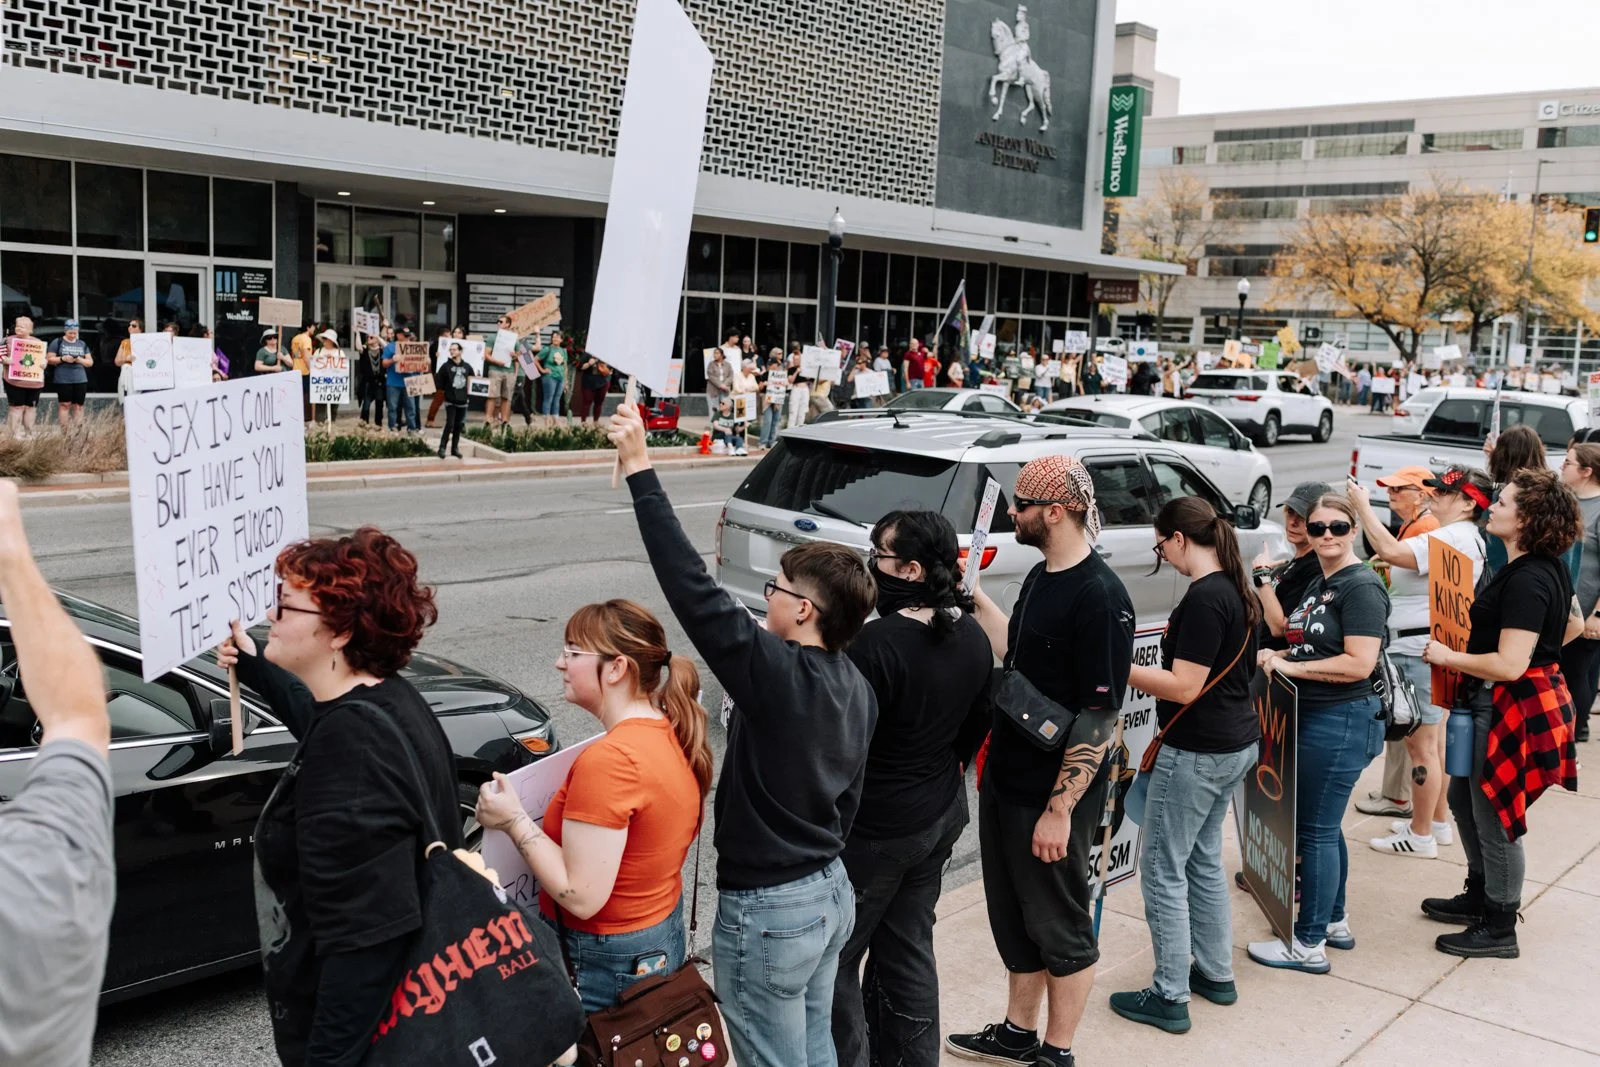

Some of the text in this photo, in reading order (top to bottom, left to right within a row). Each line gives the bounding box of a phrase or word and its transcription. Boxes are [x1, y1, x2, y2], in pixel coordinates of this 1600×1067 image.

[1110, 115, 1129, 192] WesBanco
[13, 370, 40, 378] RESIST!
[315, 356, 348, 369] SAVE
[315, 385, 348, 393] IMPEACH
[319, 394, 341, 402] NOW
[153, 387, 281, 464] SEX IS COOL
[155, 443, 285, 528] BUT HAVE YOU
[175, 505, 284, 589] EVER FUCKED
[1442, 548, 1461, 587] NO
[170, 594, 213, 658] THE
[1434, 580, 1472, 631] KINGS
[1116, 708, 1151, 730] EVENT
[215, 835, 255, 850] MAL
[1249, 809, 1288, 876] NO FAUX
[1247, 836, 1290, 909] KING WAY
[497, 950, 540, 980] BALL
